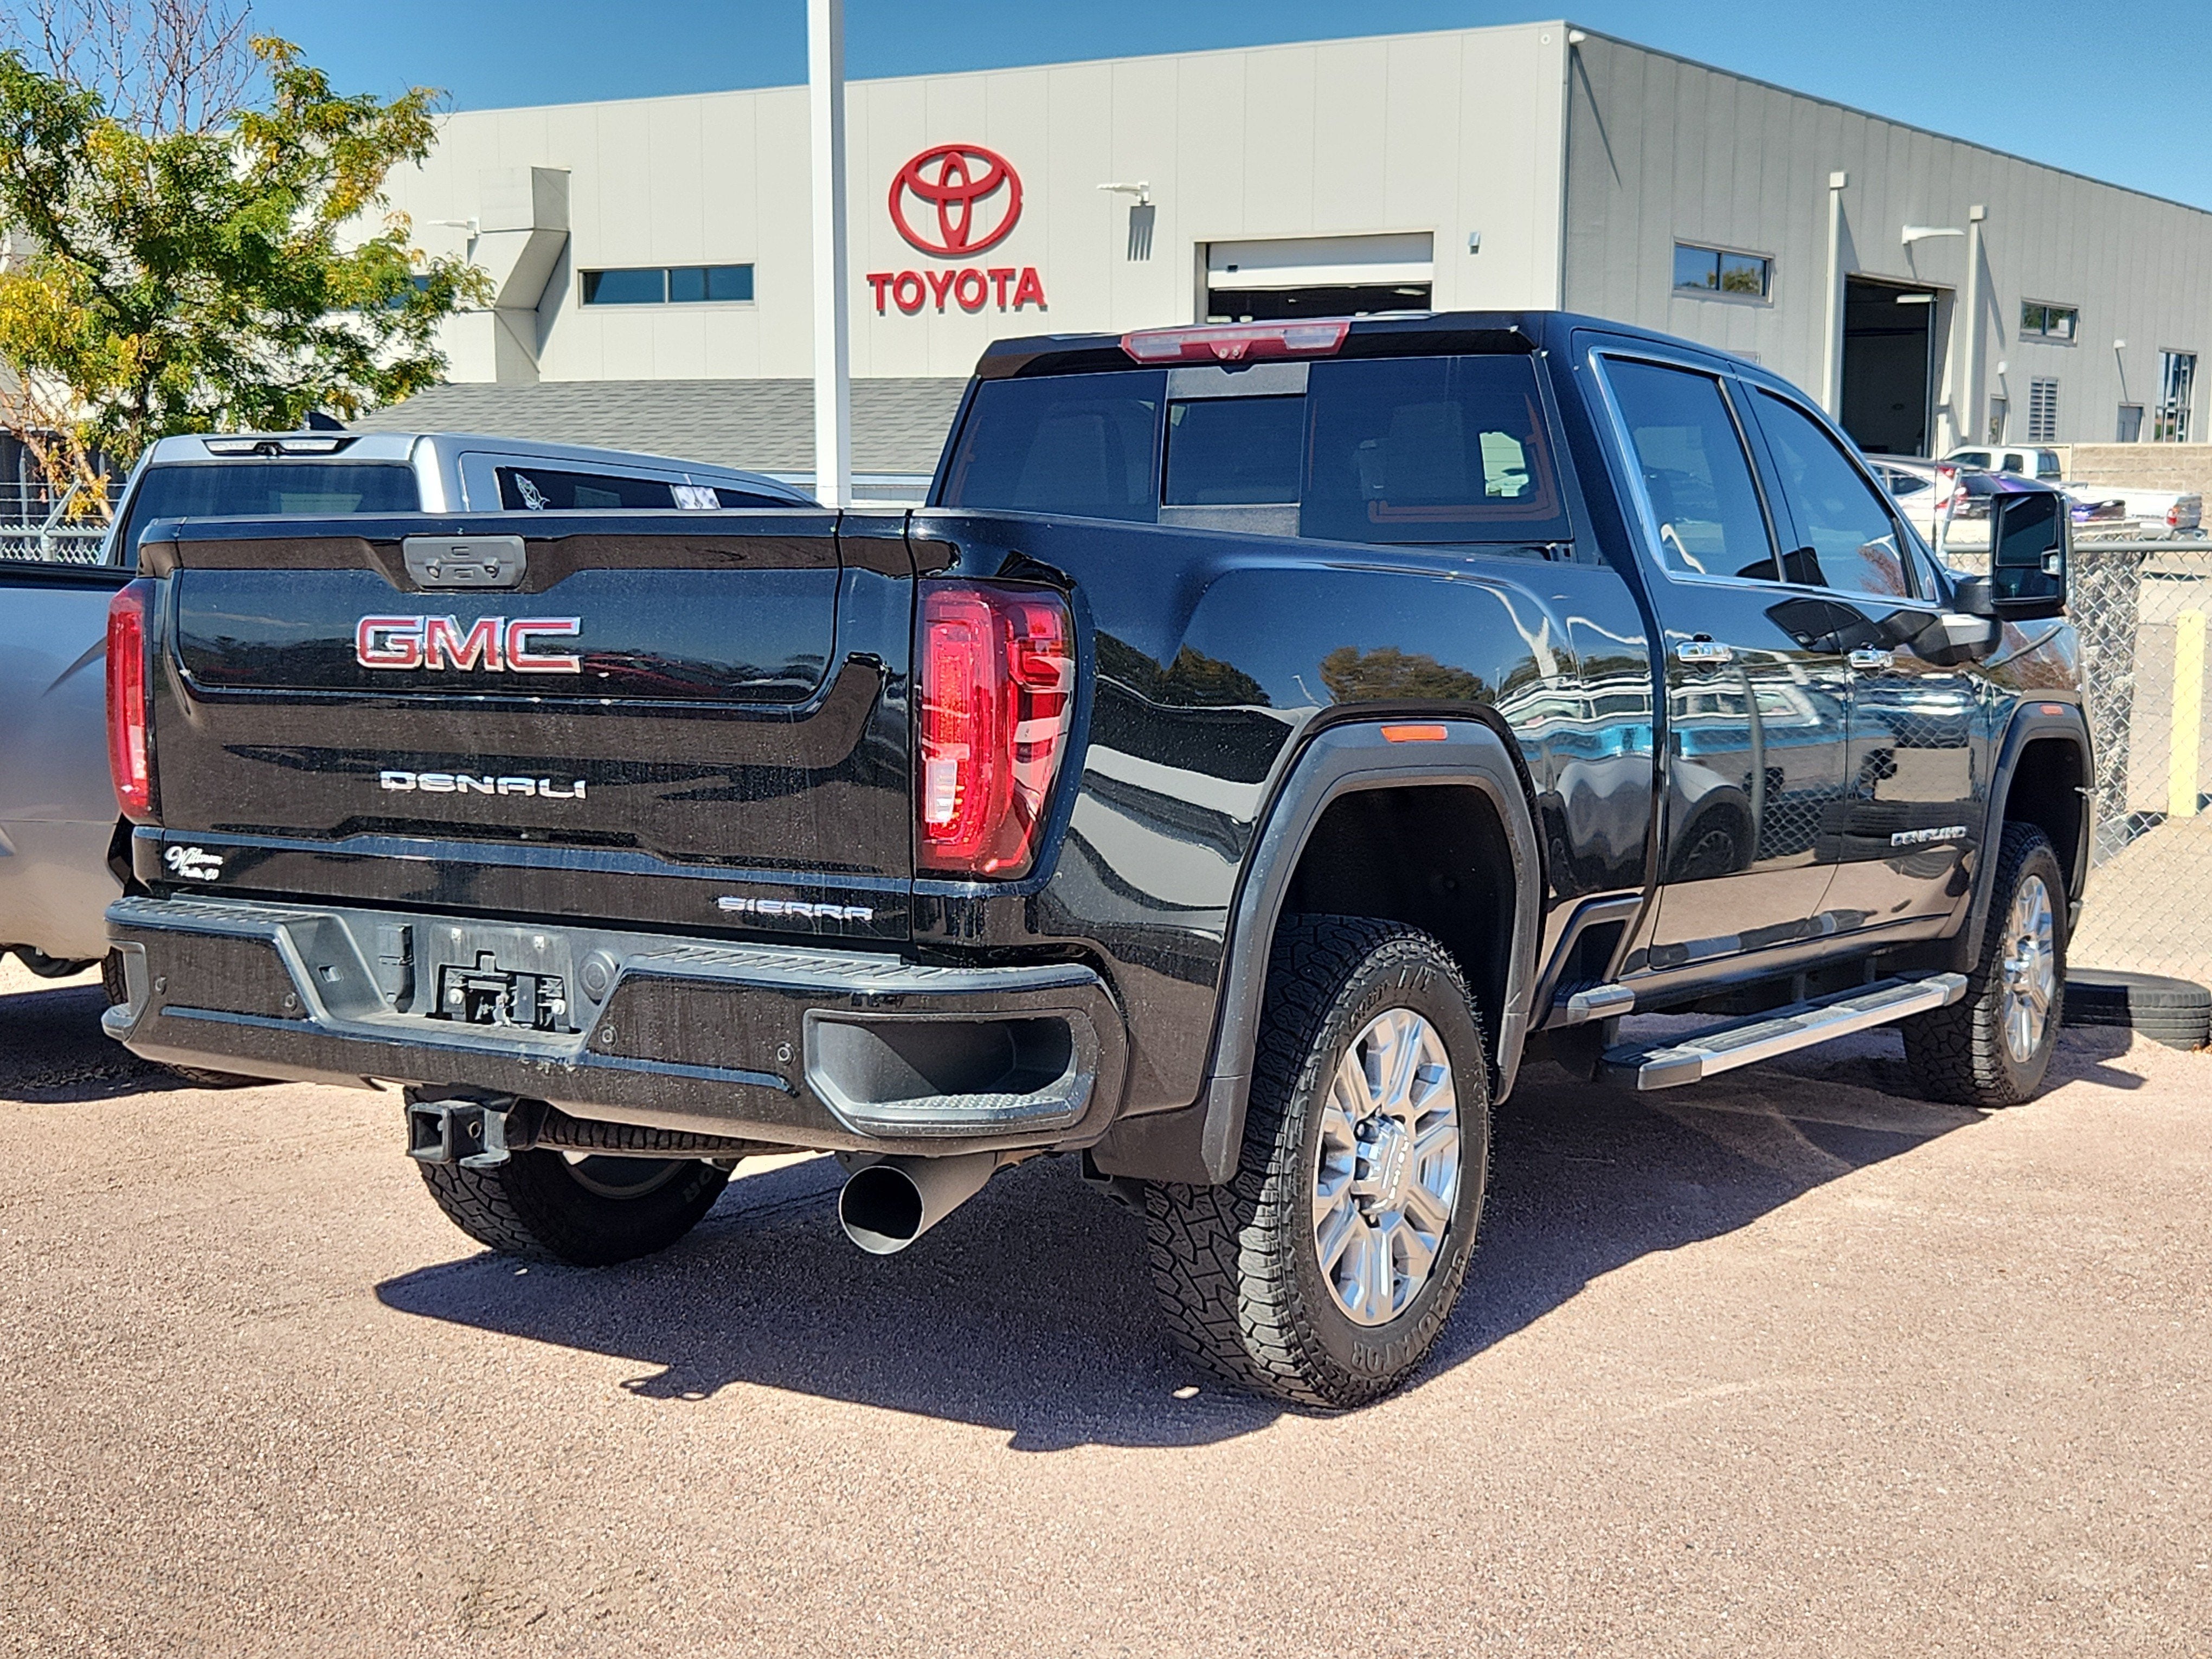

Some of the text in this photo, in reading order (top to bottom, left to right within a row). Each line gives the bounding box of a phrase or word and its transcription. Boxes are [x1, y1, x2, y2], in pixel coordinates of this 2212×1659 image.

[866, 267, 1047, 312] TOYOTA
[356, 614, 584, 673] GMC
[380, 771, 586, 799] DENALI
[717, 896, 873, 921] SIERRA
